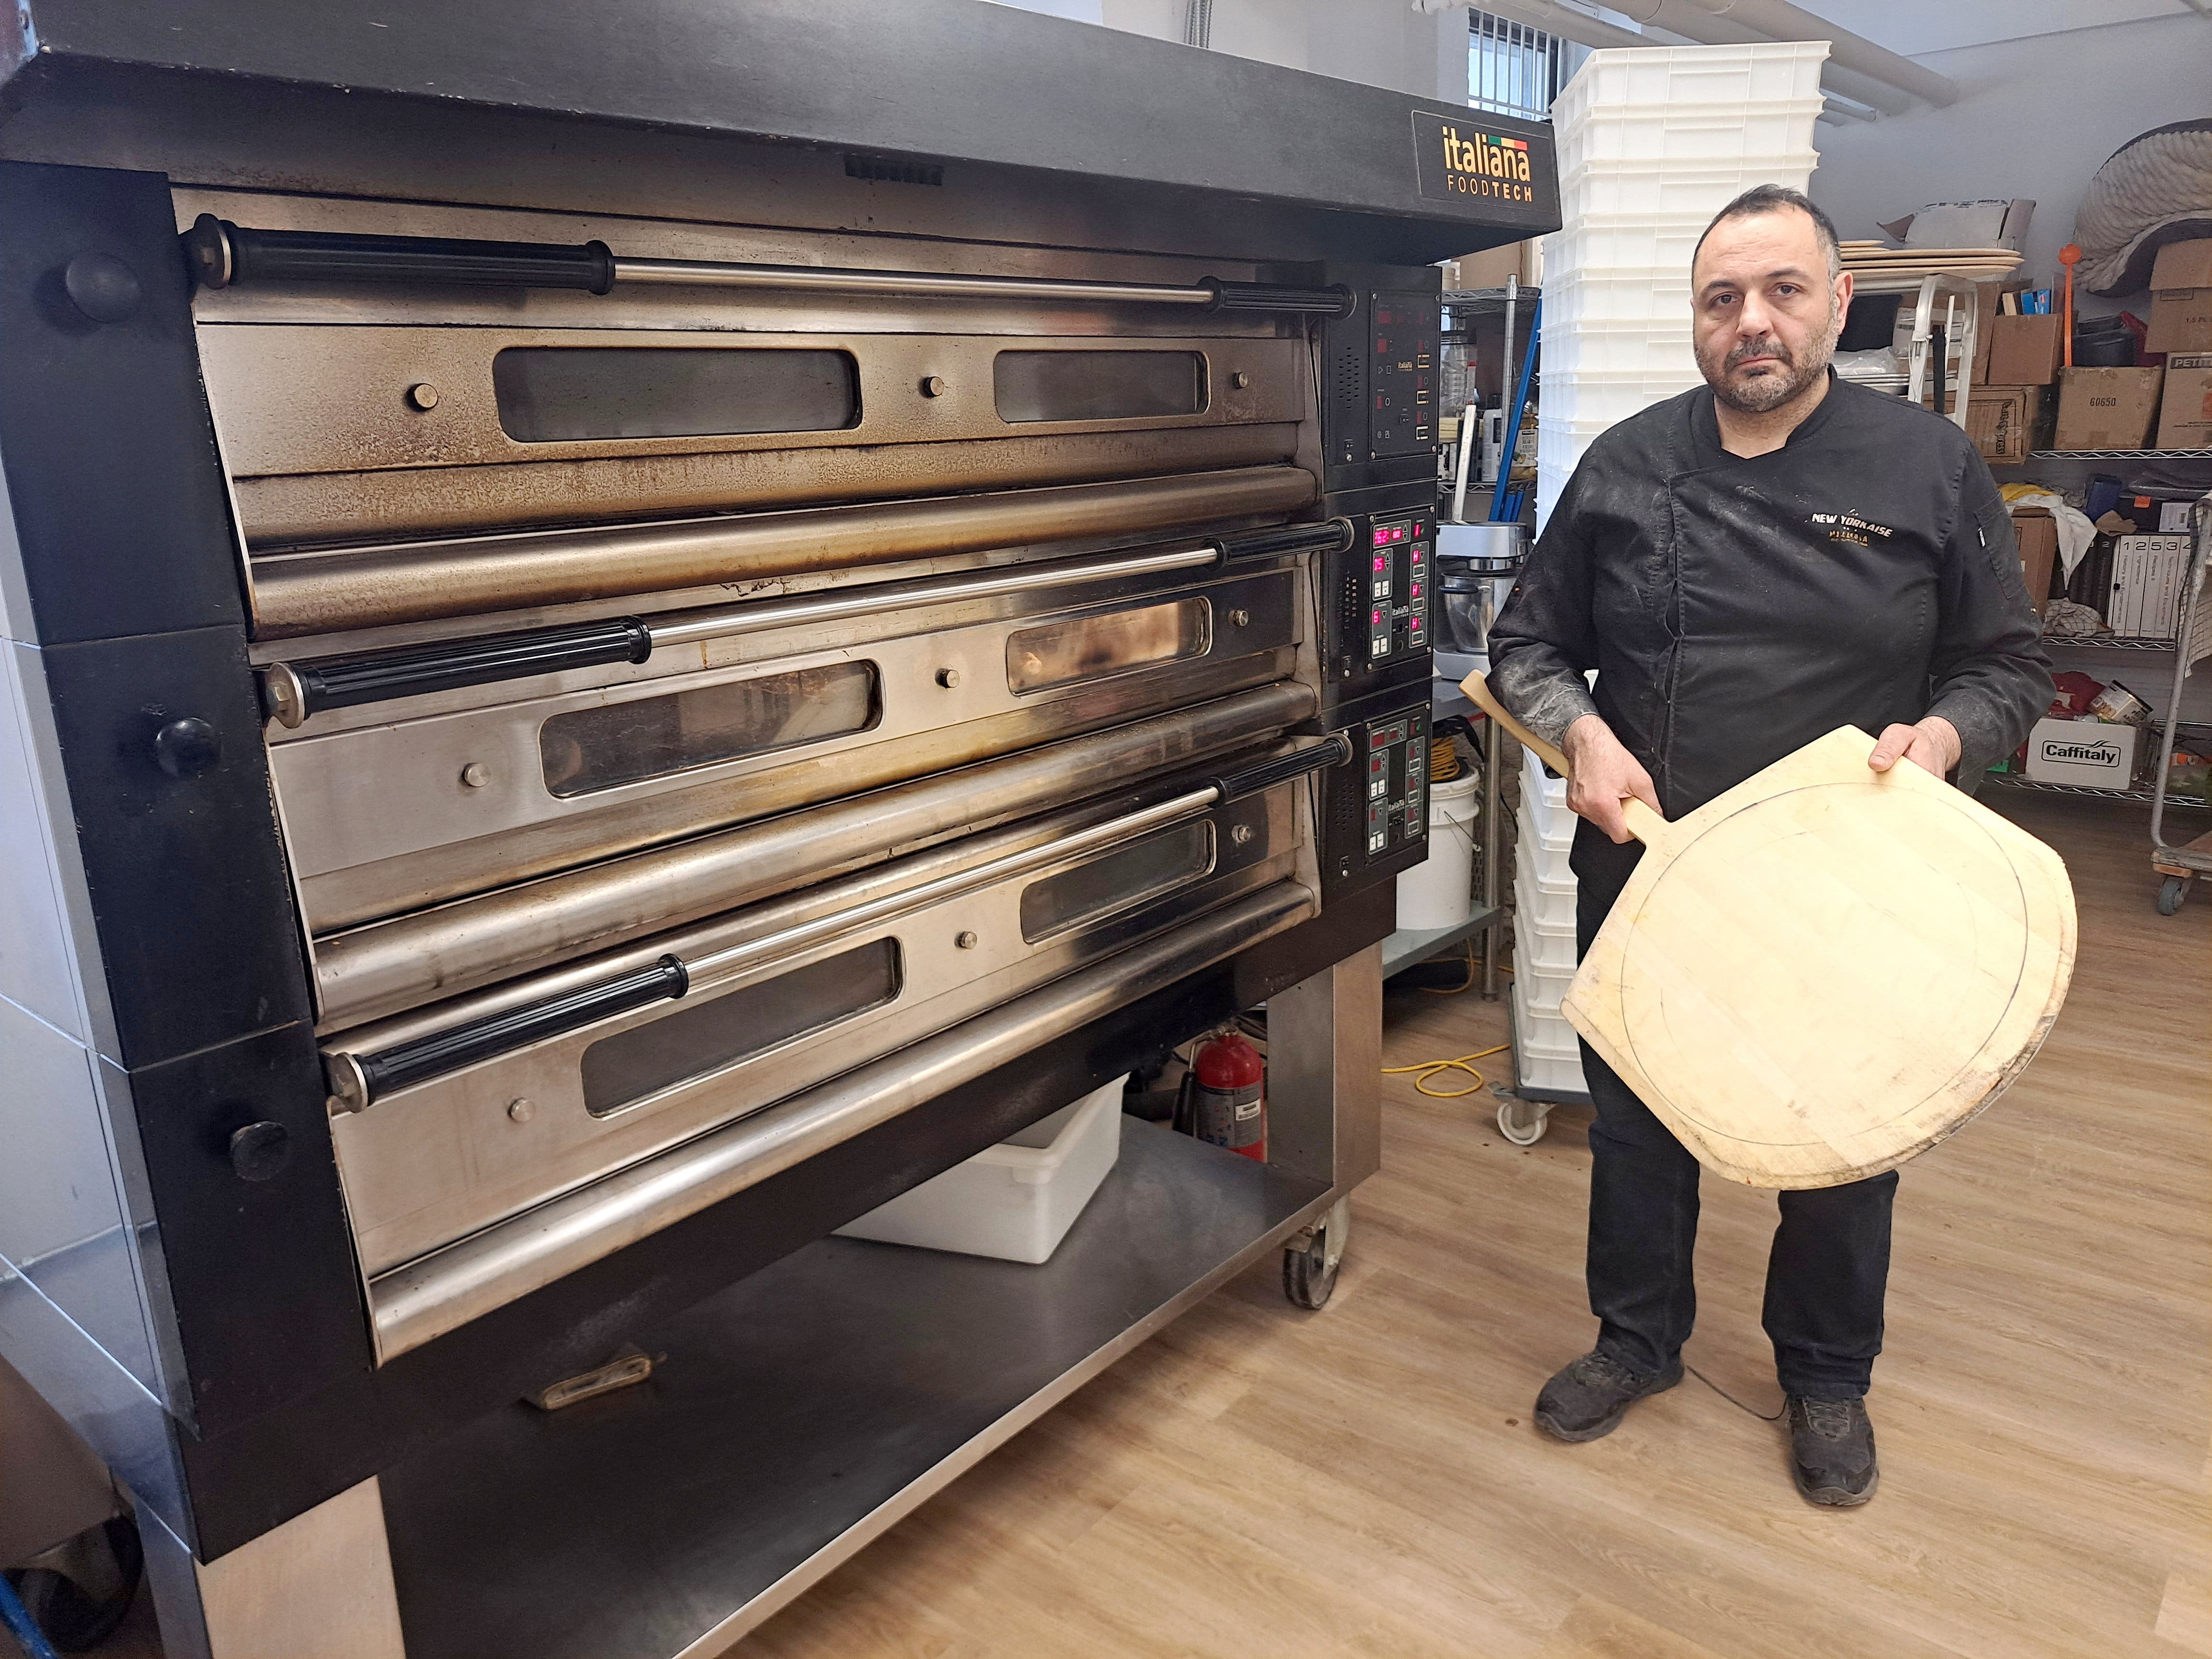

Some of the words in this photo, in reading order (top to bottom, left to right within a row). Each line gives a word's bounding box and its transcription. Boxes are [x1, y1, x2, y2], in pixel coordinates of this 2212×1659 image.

[1442, 126, 1531, 182] italiana
[1447, 174, 1533, 203] FOODTECH
[2090, 398, 2116, 407] 60650
[1812, 513, 1837, 524] NEW
[2123, 542, 2129, 550] 1
[2135, 542, 2147, 550] 2
[2151, 542, 2162, 550] 5
[2166, 542, 2178, 550] 3
[2046, 744, 2117, 764] Caffitaly
